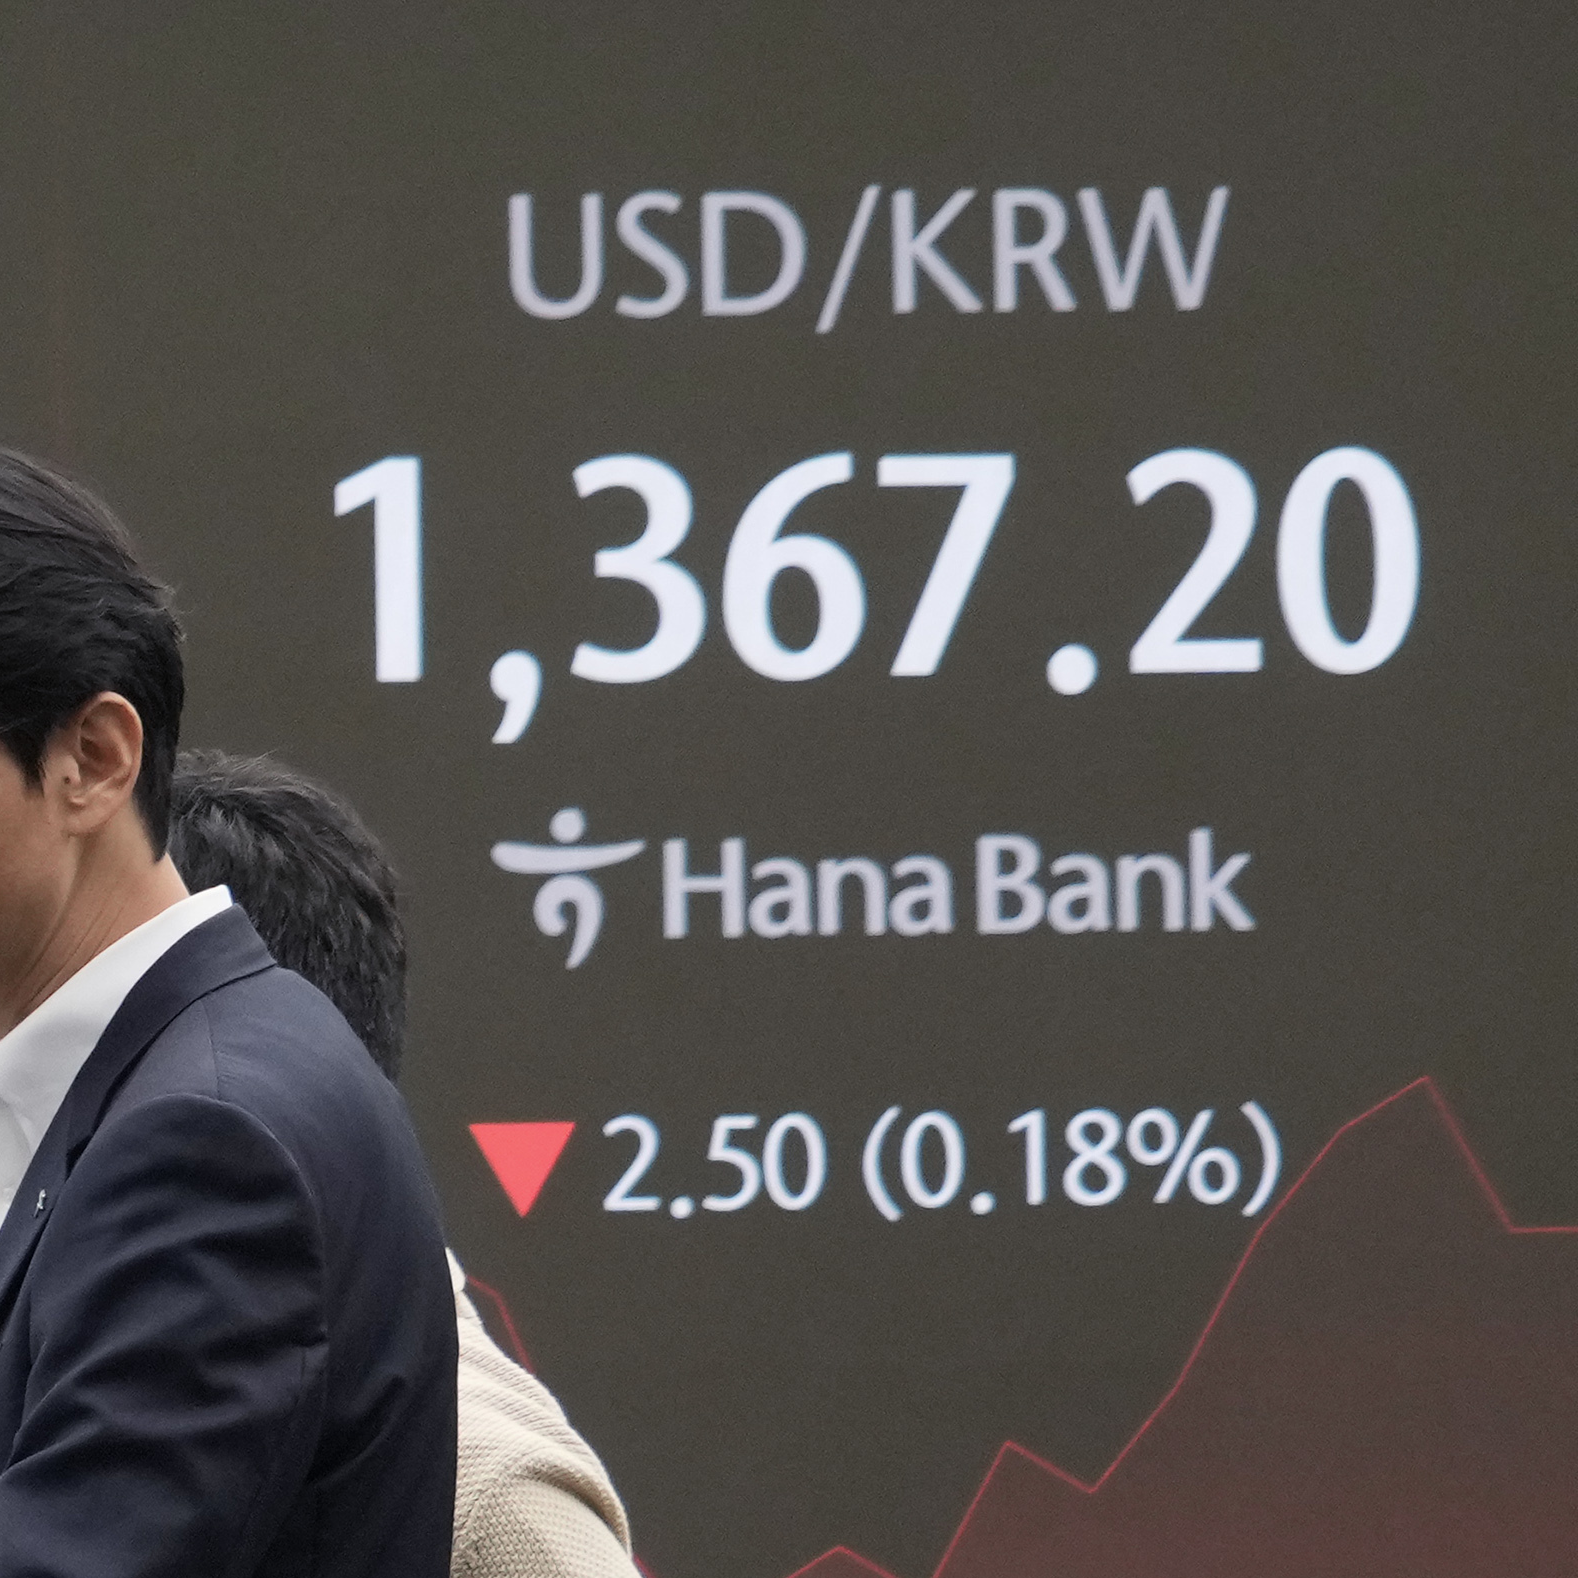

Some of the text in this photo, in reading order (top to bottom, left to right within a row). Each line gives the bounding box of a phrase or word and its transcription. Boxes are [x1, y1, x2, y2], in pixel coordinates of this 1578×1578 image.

[507, 184, 1230, 334] USD/KRW
[332, 445, 1422, 745] 1,367.20
[661, 826, 1255, 940] Hana Bank
[601, 1100, 1282, 1223] 2.50 (0.18%)
